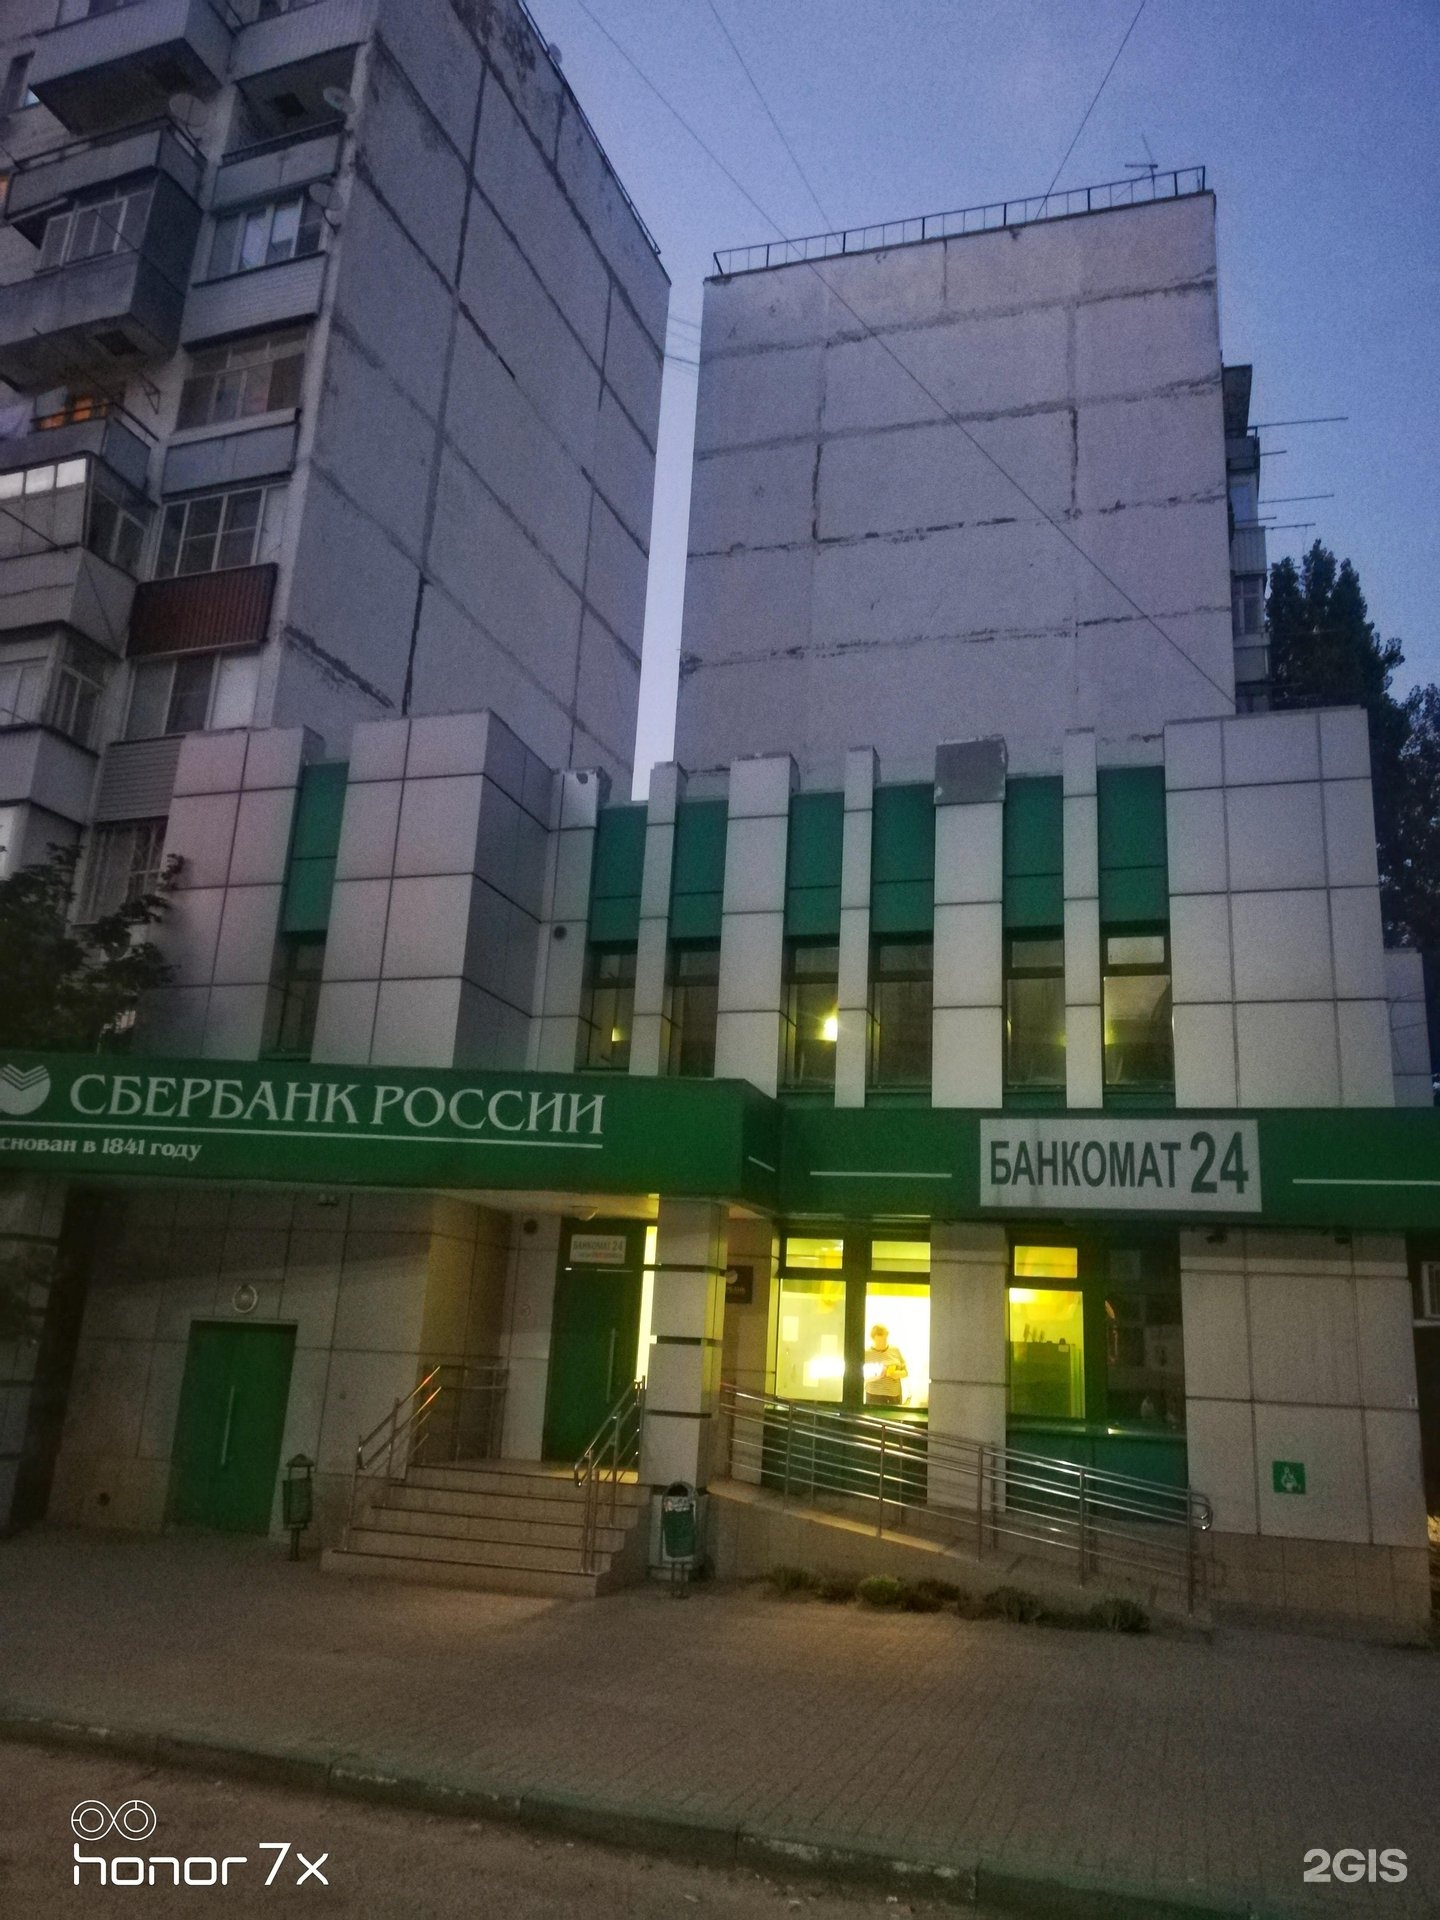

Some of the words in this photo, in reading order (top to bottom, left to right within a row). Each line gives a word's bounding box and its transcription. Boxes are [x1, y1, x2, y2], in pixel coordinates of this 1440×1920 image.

[70, 1073, 359, 1125] СБЕРБАНК
[370, 1083, 606, 1136] РОССИИ
[82, 1140, 97, 1153] в
[102, 1138, 145, 1155] 1841
[150, 1143, 202, 1161] году
[990, 1140, 1182, 1188] БАНКОМАТ
[1190, 1131, 1249, 1194] 24
